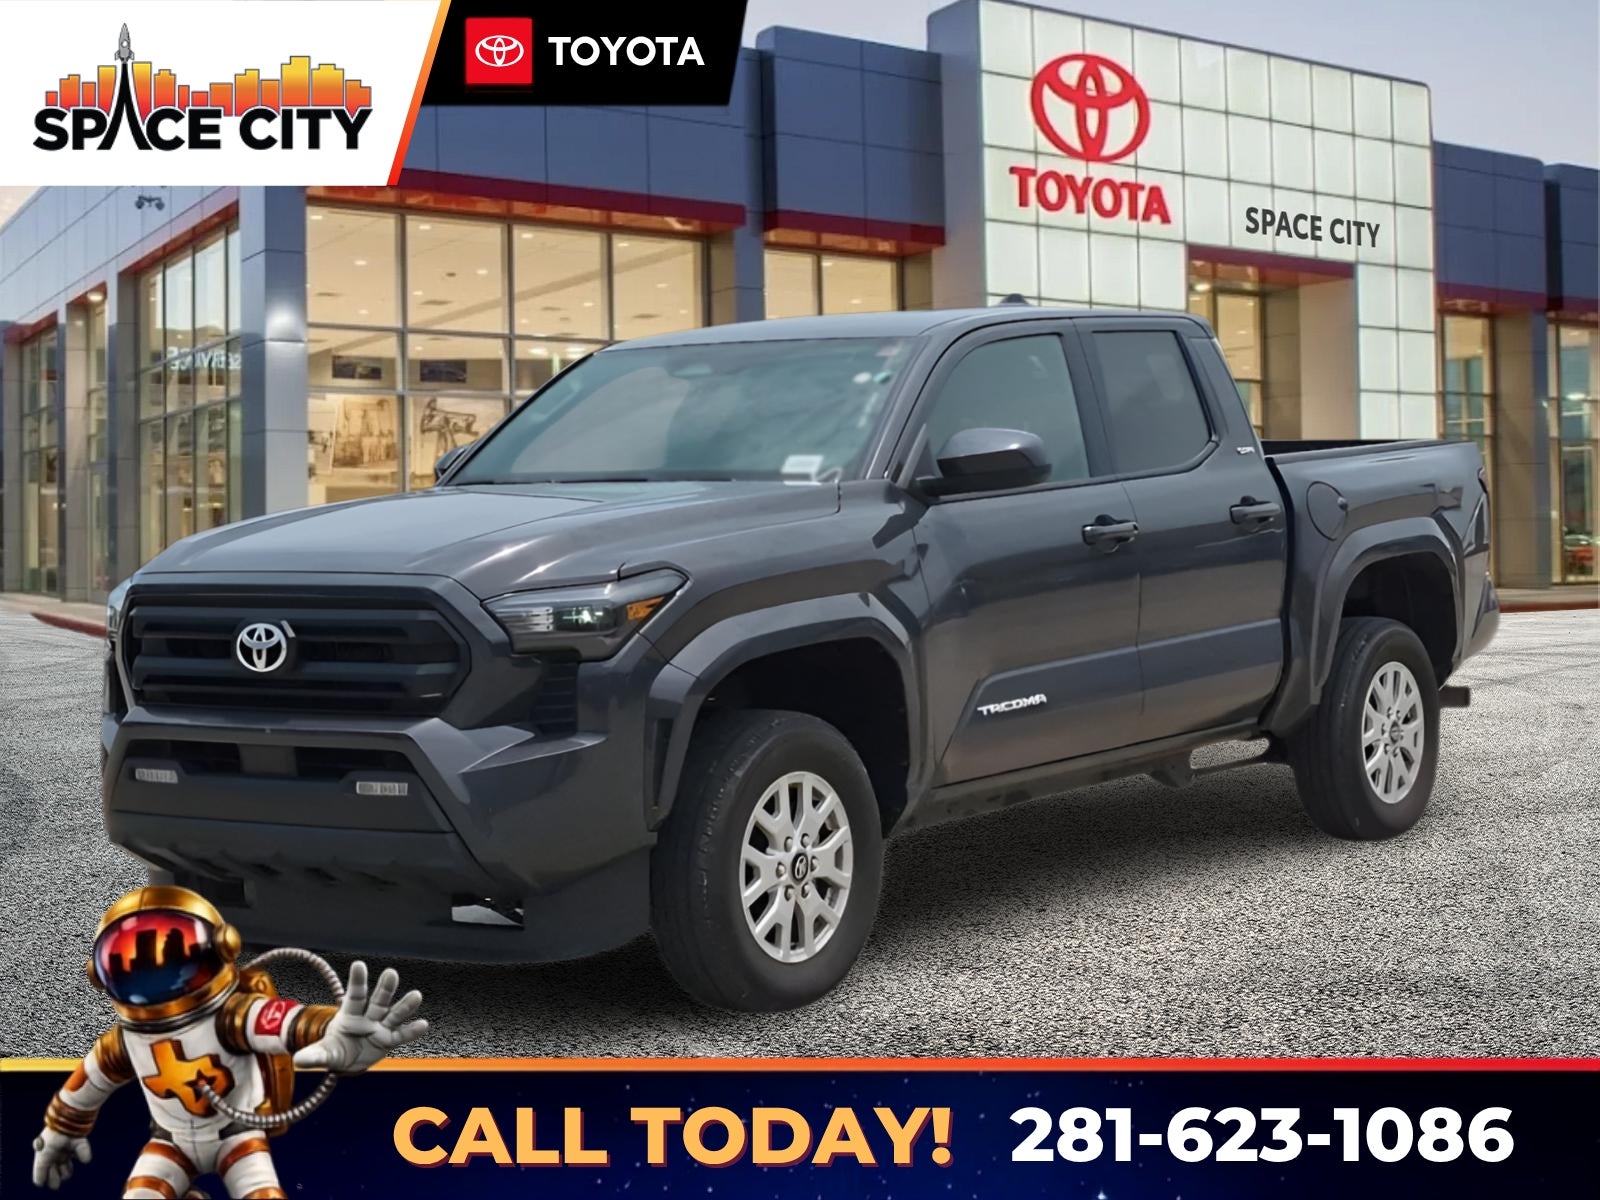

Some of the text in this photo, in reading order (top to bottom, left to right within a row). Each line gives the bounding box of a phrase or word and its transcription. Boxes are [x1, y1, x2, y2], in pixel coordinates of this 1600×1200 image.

[1010, 165, 1170, 225] TOYOTA
[1245, 206, 1380, 248] SPACE CITY
[977, 693, 1048, 716] TACOMA
